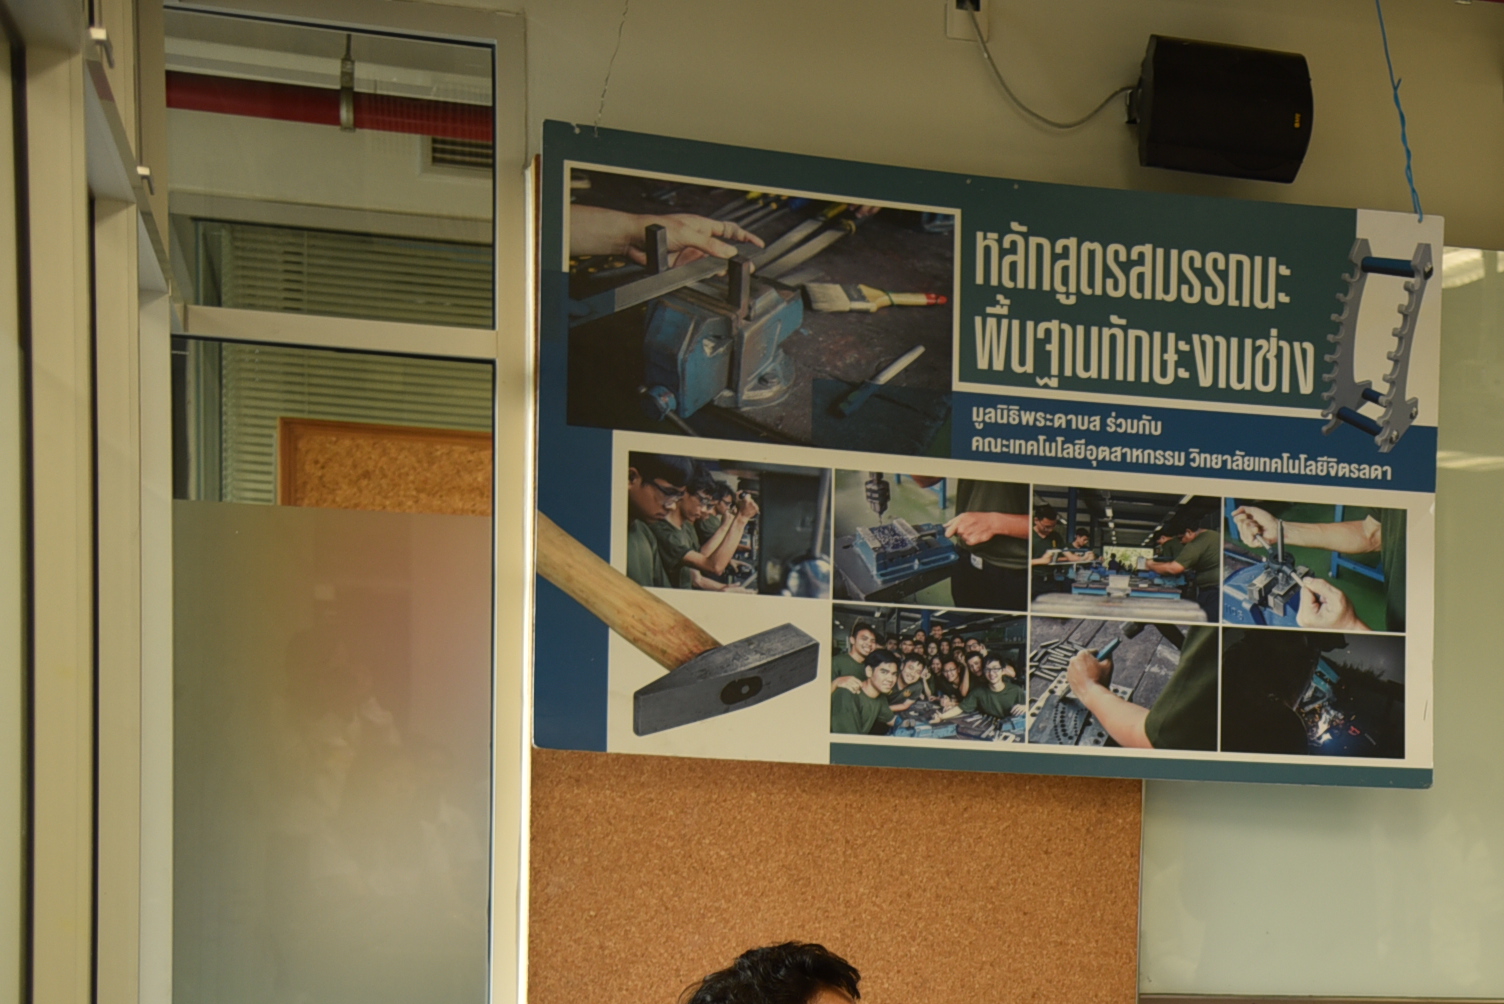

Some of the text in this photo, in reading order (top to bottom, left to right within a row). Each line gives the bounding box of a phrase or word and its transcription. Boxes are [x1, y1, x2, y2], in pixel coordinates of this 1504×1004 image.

[974, 221, 1291, 310] หลักสูตรสมรรถนะ
[974, 294, 1315, 395] พื้นฐานทักษะงานช่าง
[972, 404, 1162, 436] มูลนิธิพระดาบส ร่วมกับ
[971, 435, 1392, 480] คณะเทคโนโลยีอุตสาหกรรม วิทยาลัยเทคโนโลยีจิตรลดา
